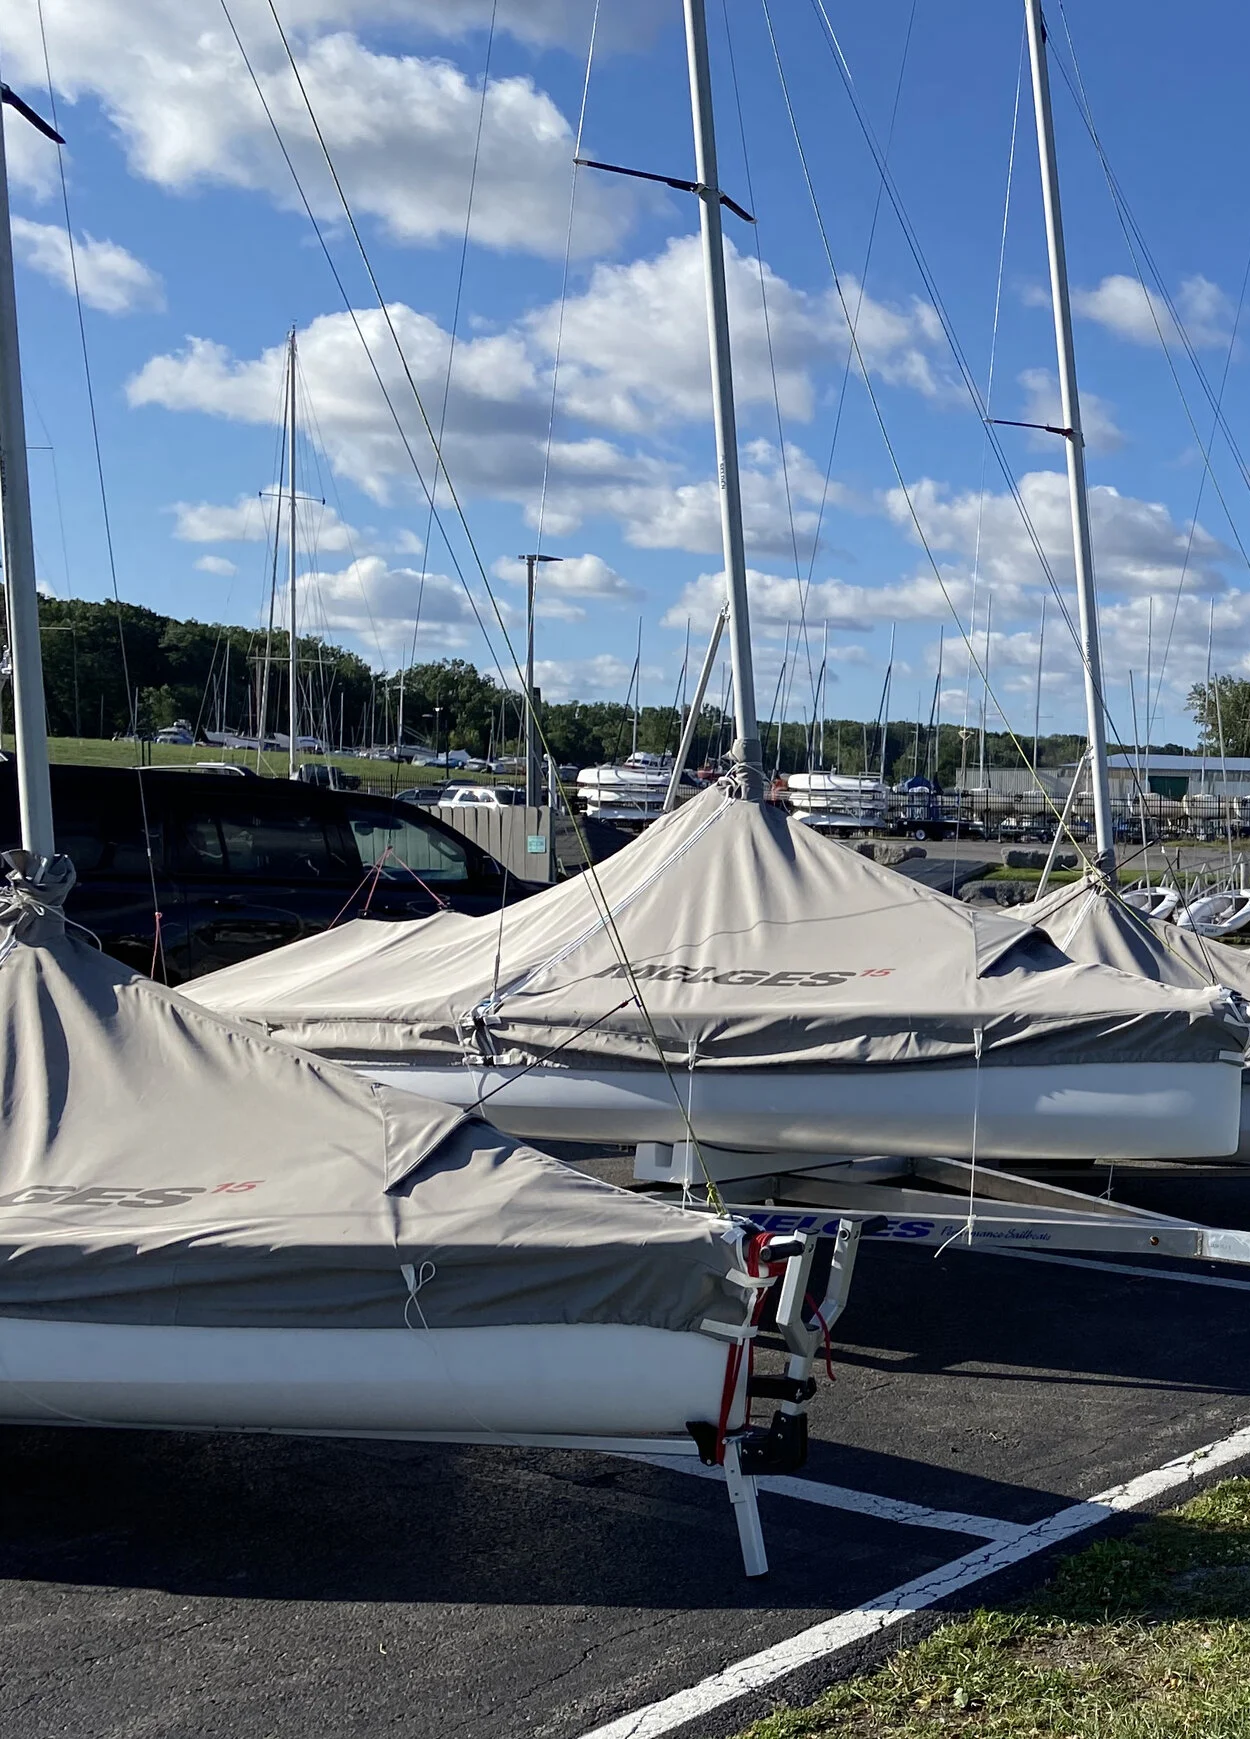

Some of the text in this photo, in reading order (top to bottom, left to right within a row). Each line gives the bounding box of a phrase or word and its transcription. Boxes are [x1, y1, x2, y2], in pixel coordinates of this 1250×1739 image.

[591, 963, 897, 987] MELGES 15
[210, 1180, 266, 1194] 15
